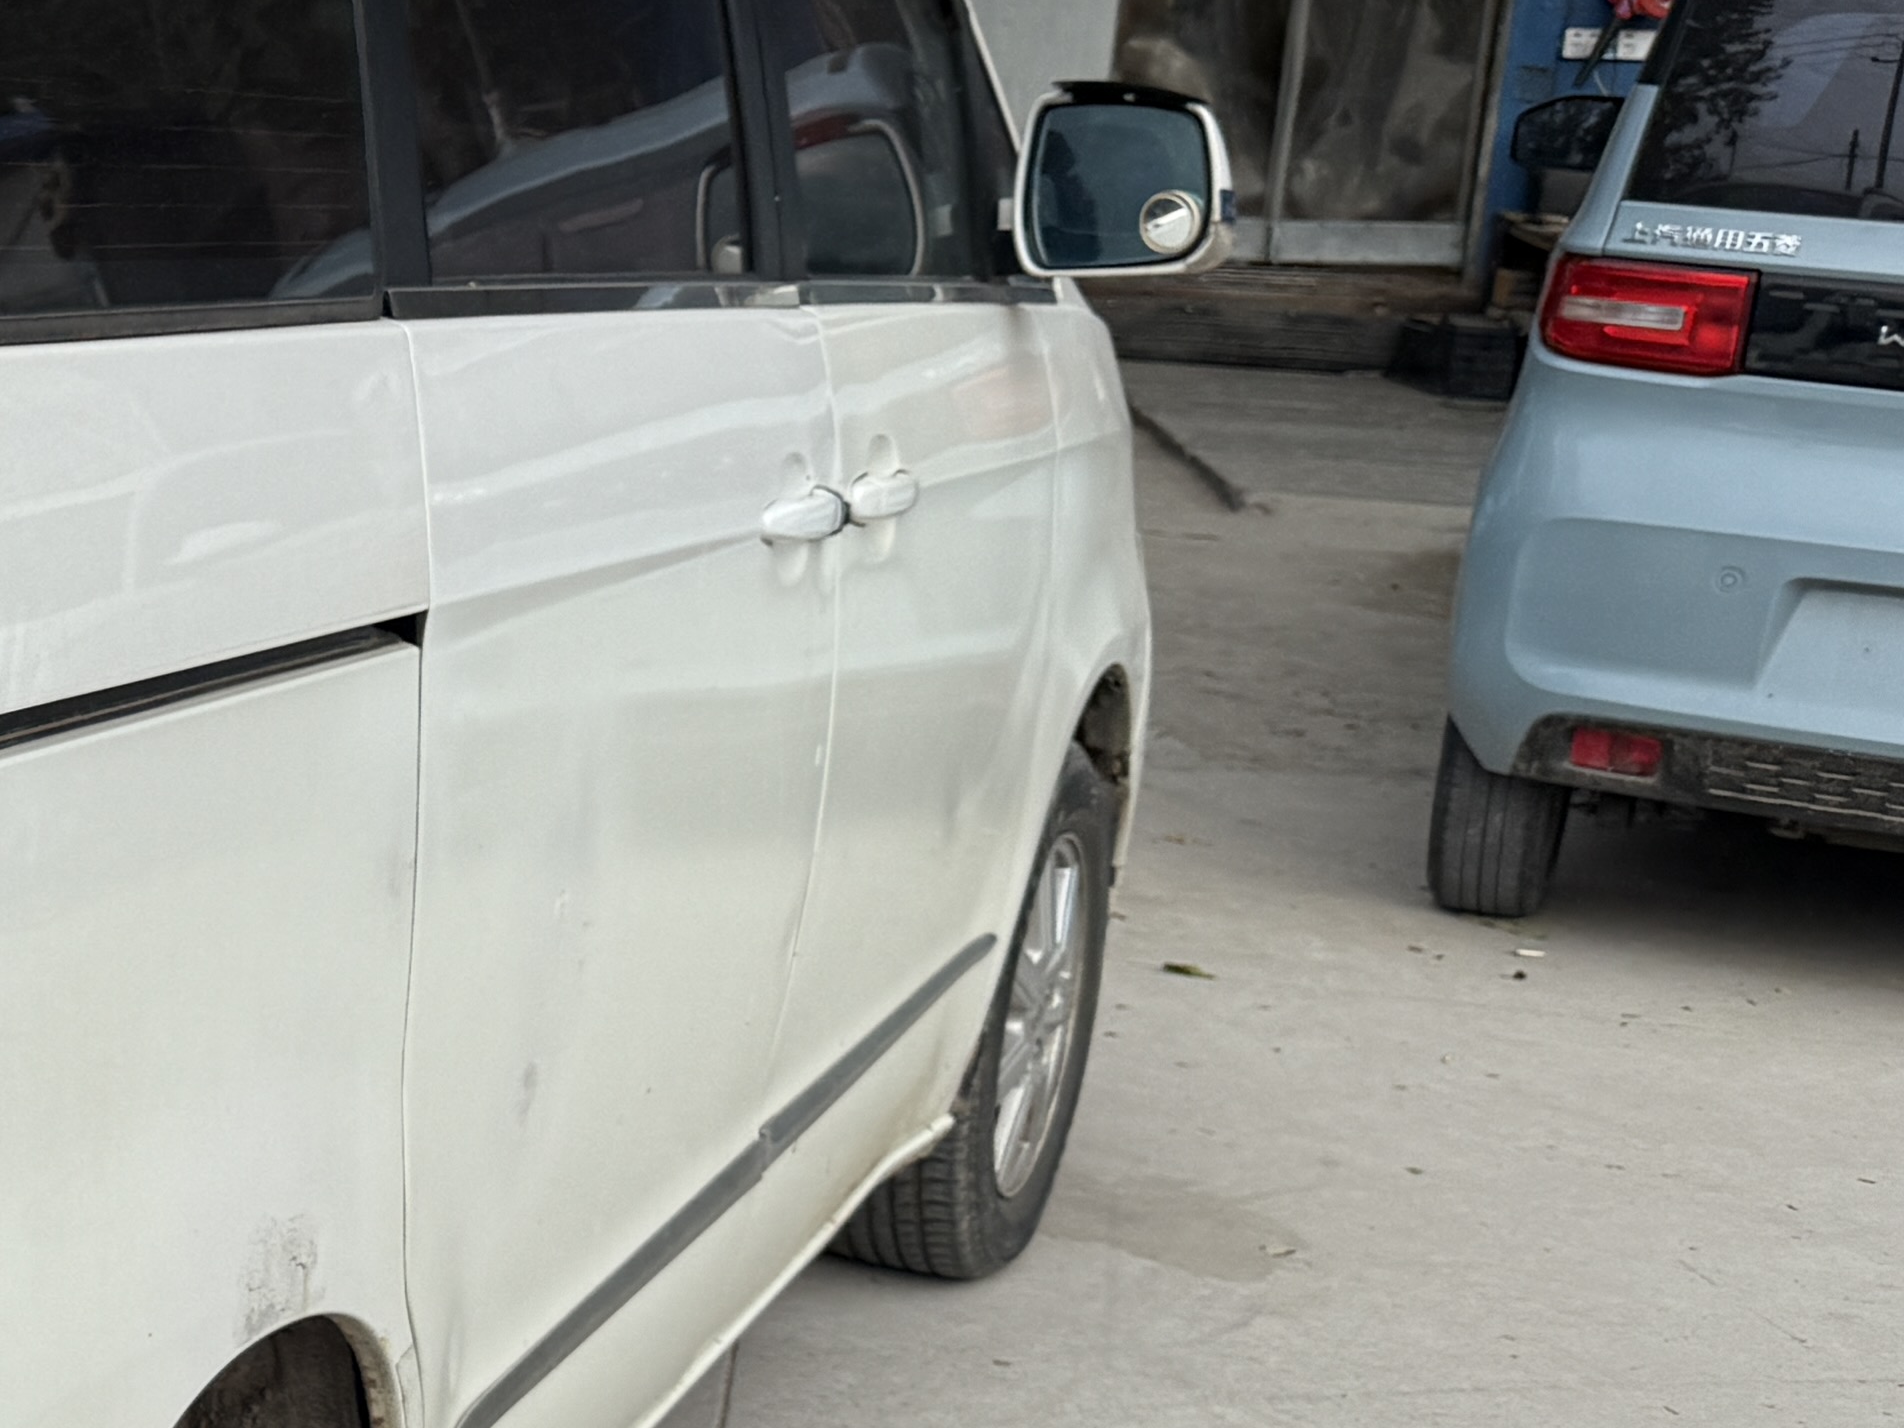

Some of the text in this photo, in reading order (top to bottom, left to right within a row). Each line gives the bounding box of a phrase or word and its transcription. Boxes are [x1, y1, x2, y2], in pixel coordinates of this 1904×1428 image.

[1623, 220, 1802, 257] 上汽通用五菱
